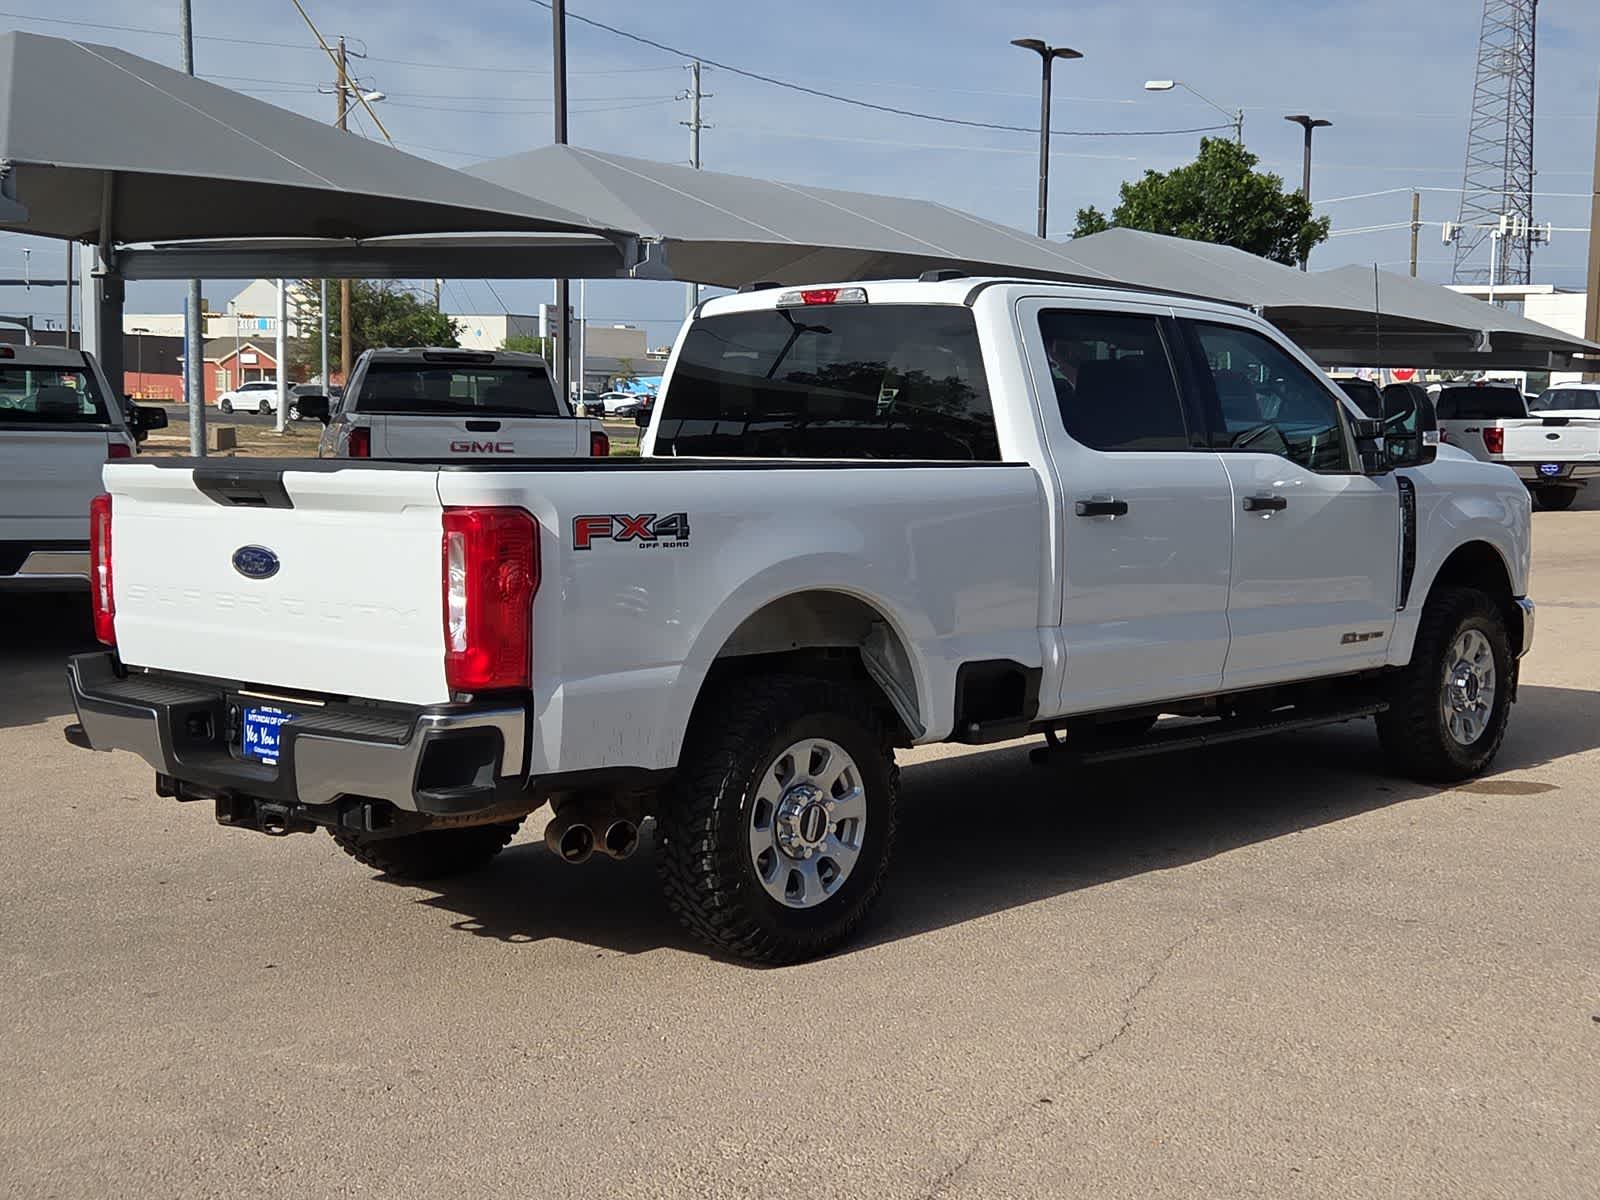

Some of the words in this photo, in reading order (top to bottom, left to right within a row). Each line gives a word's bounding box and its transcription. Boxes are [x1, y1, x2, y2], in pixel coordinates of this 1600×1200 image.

[450, 441, 514, 453] GMC
[572, 513, 690, 550] FX4
[246, 725, 258, 743] Yes
[261, 727, 275, 745] You
